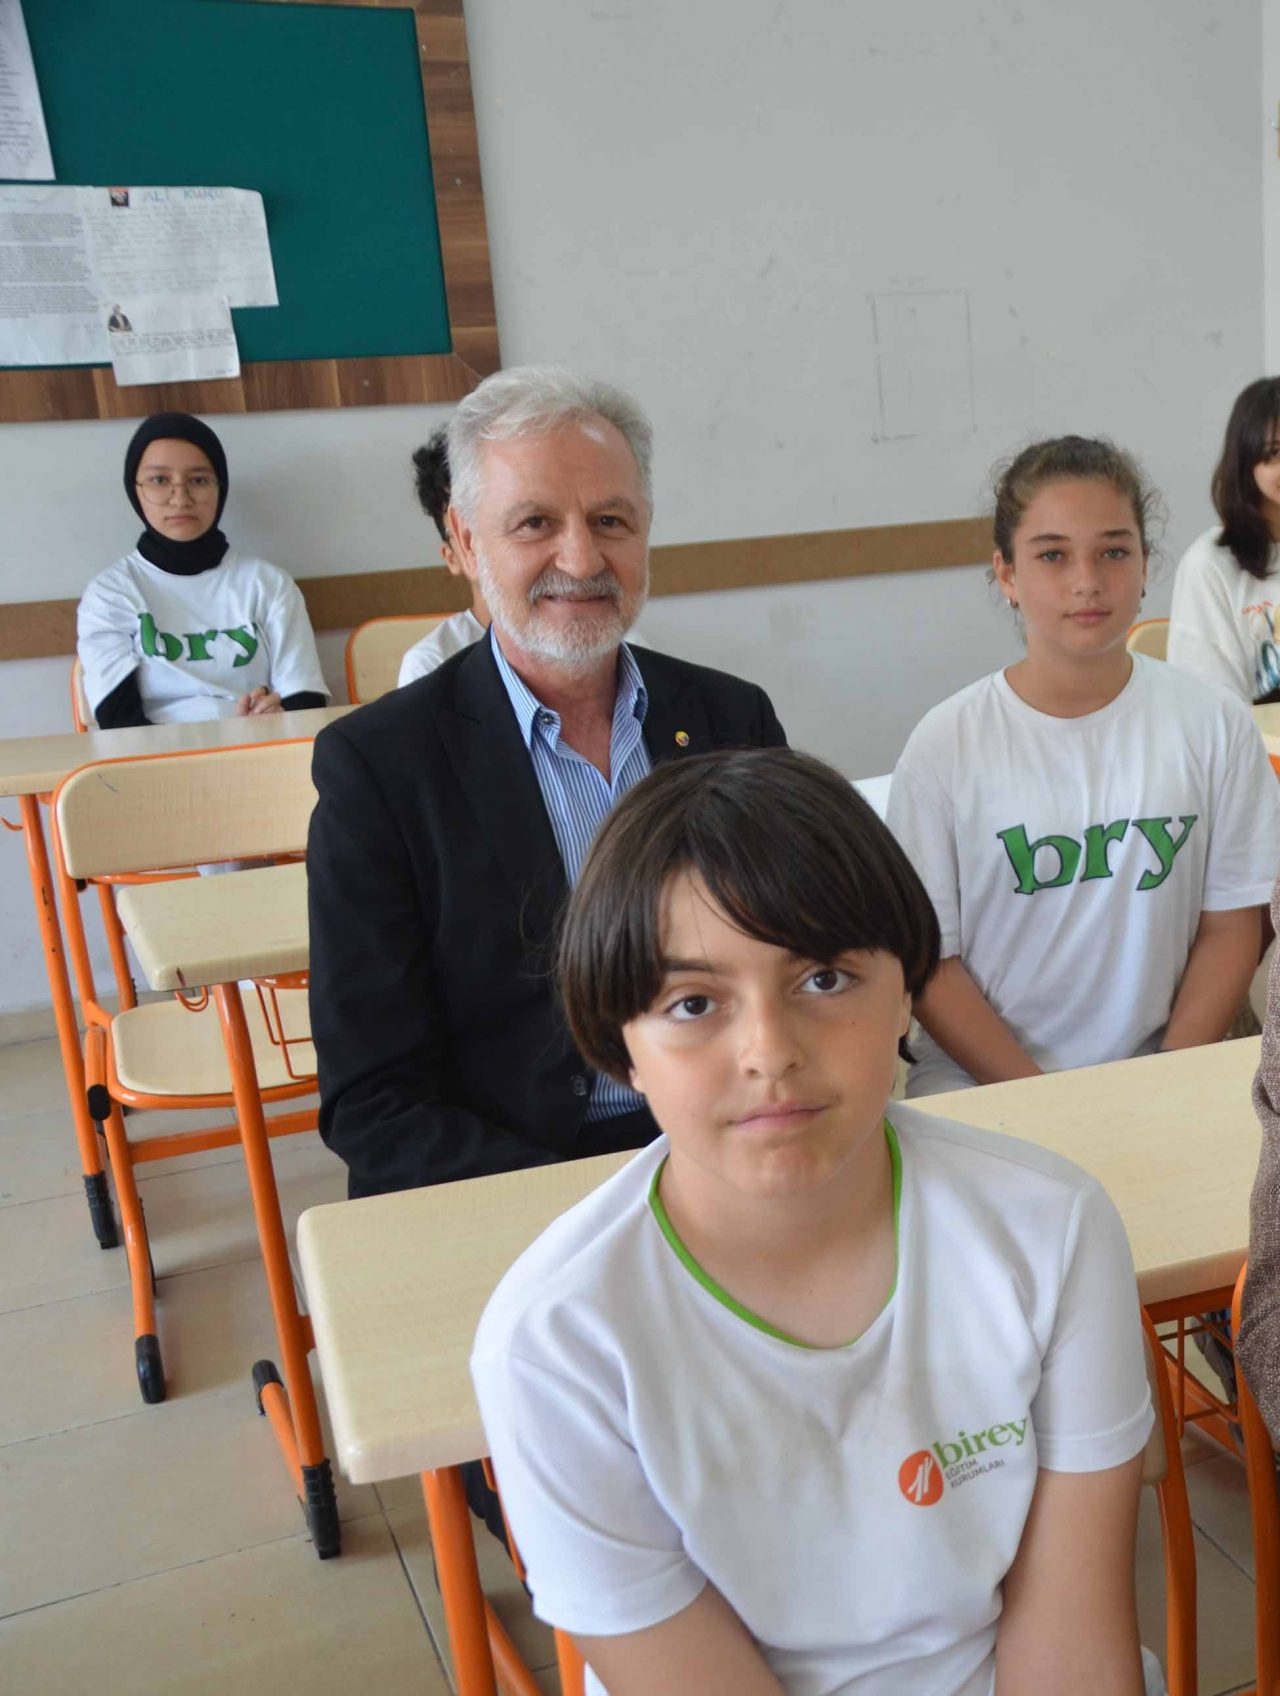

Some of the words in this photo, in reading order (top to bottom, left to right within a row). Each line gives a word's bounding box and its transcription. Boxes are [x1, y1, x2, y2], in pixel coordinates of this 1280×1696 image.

[137, 612, 258, 668] bry
[996, 814, 1198, 895] bry
[932, 1418, 1027, 1469] birey
